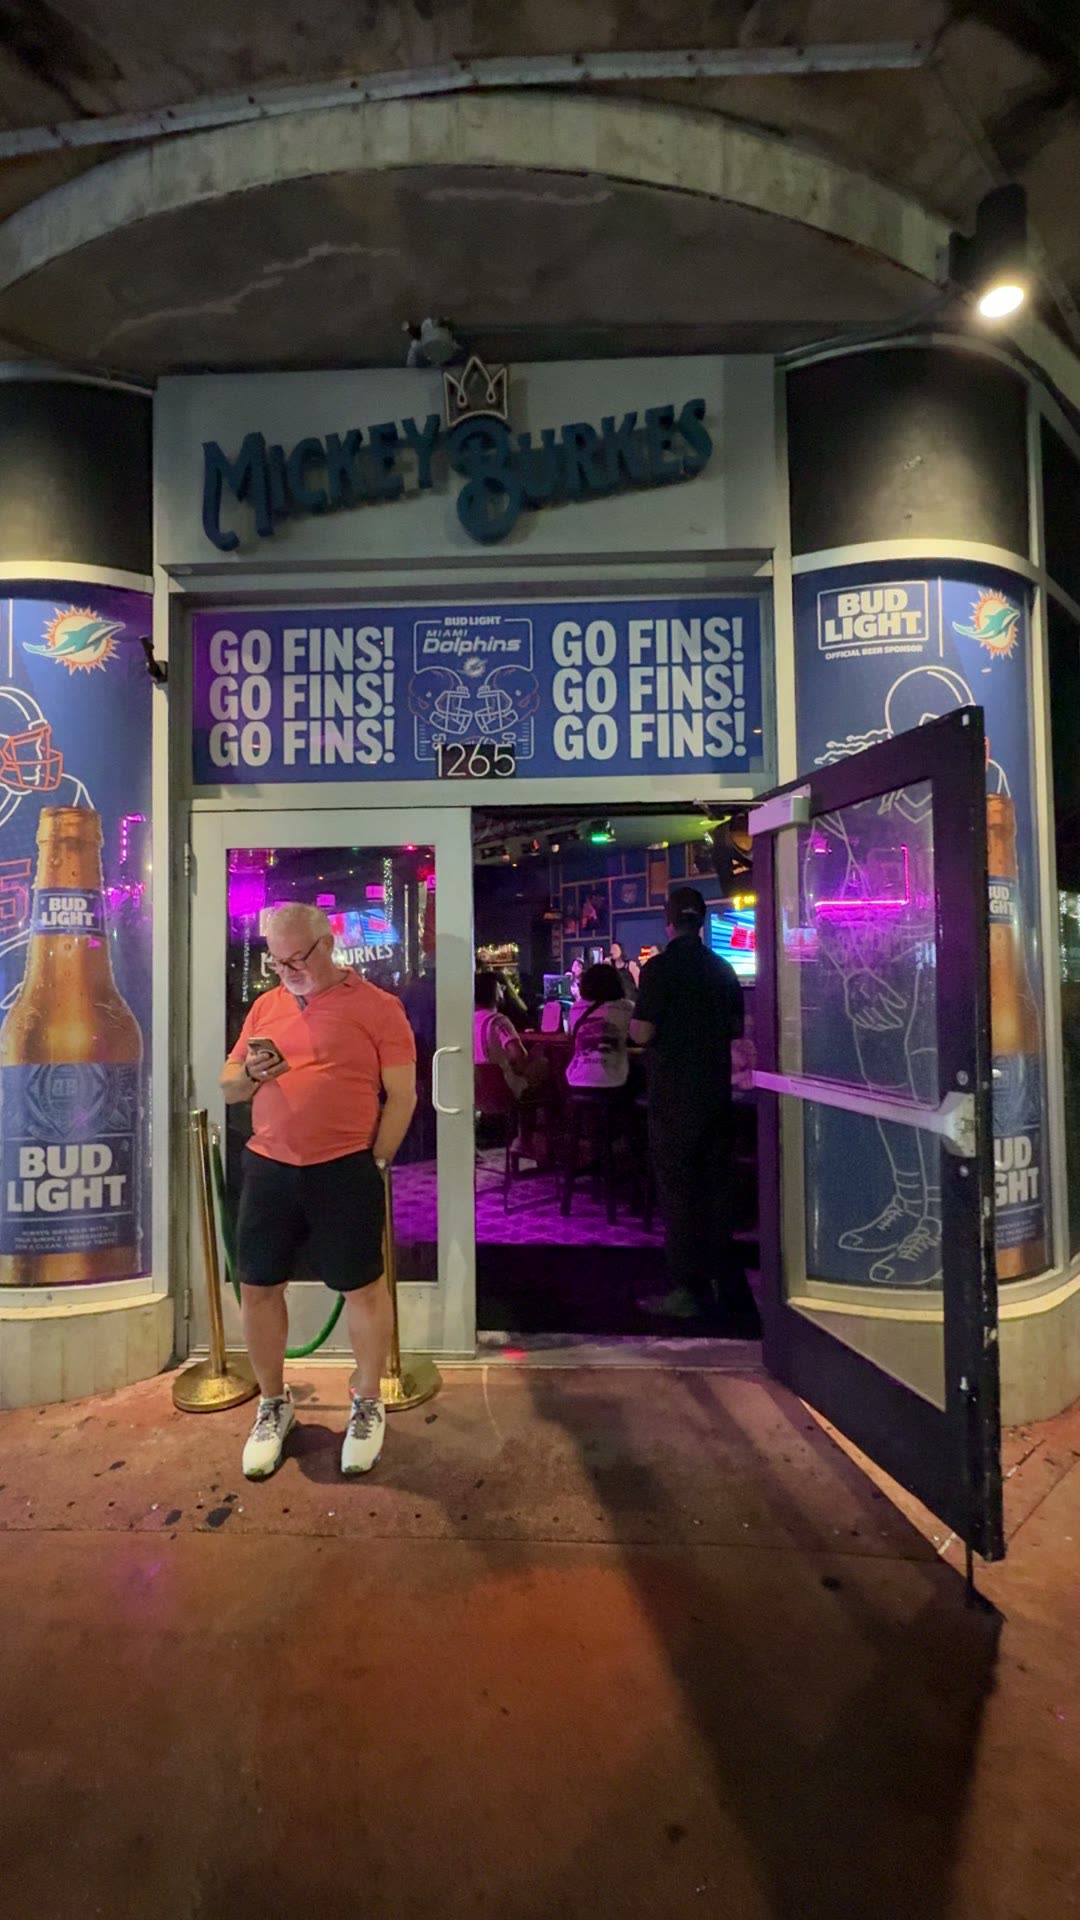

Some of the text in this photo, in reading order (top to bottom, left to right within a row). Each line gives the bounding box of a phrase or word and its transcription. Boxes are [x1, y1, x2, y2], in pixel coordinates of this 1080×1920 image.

[449, 398, 713, 546] BURKES
[838, 588, 908, 617] BUD
[426, 629, 468, 638] MIAMI
[444, 616, 501, 626] BUD LIGHT
[825, 611, 922, 642] LIGHT
[209, 626, 395, 675] GO FINS!
[422, 636, 522, 656] Dolphins
[552, 617, 745, 667] GO FINS!
[825, 645, 923, 660] OFFICIAL BEER SPONSOR
[209, 672, 395, 720] GO FINS!
[552, 664, 746, 714] GO FINS!
[208, 719, 396, 767] GO FINS!
[553, 711, 747, 761] GO FINS!
[436, 737, 516, 778] 1265
[41, 912, 94, 926] LIGHT
[48, 897, 87, 911] BUD
[989, 900, 1015, 915] GHT
[19, 1144, 113, 1179] BUD
[993, 1136, 1032, 1171] UD
[7, 1175, 127, 1213] LIGHT
[994, 1167, 1039, 1207] GHT
